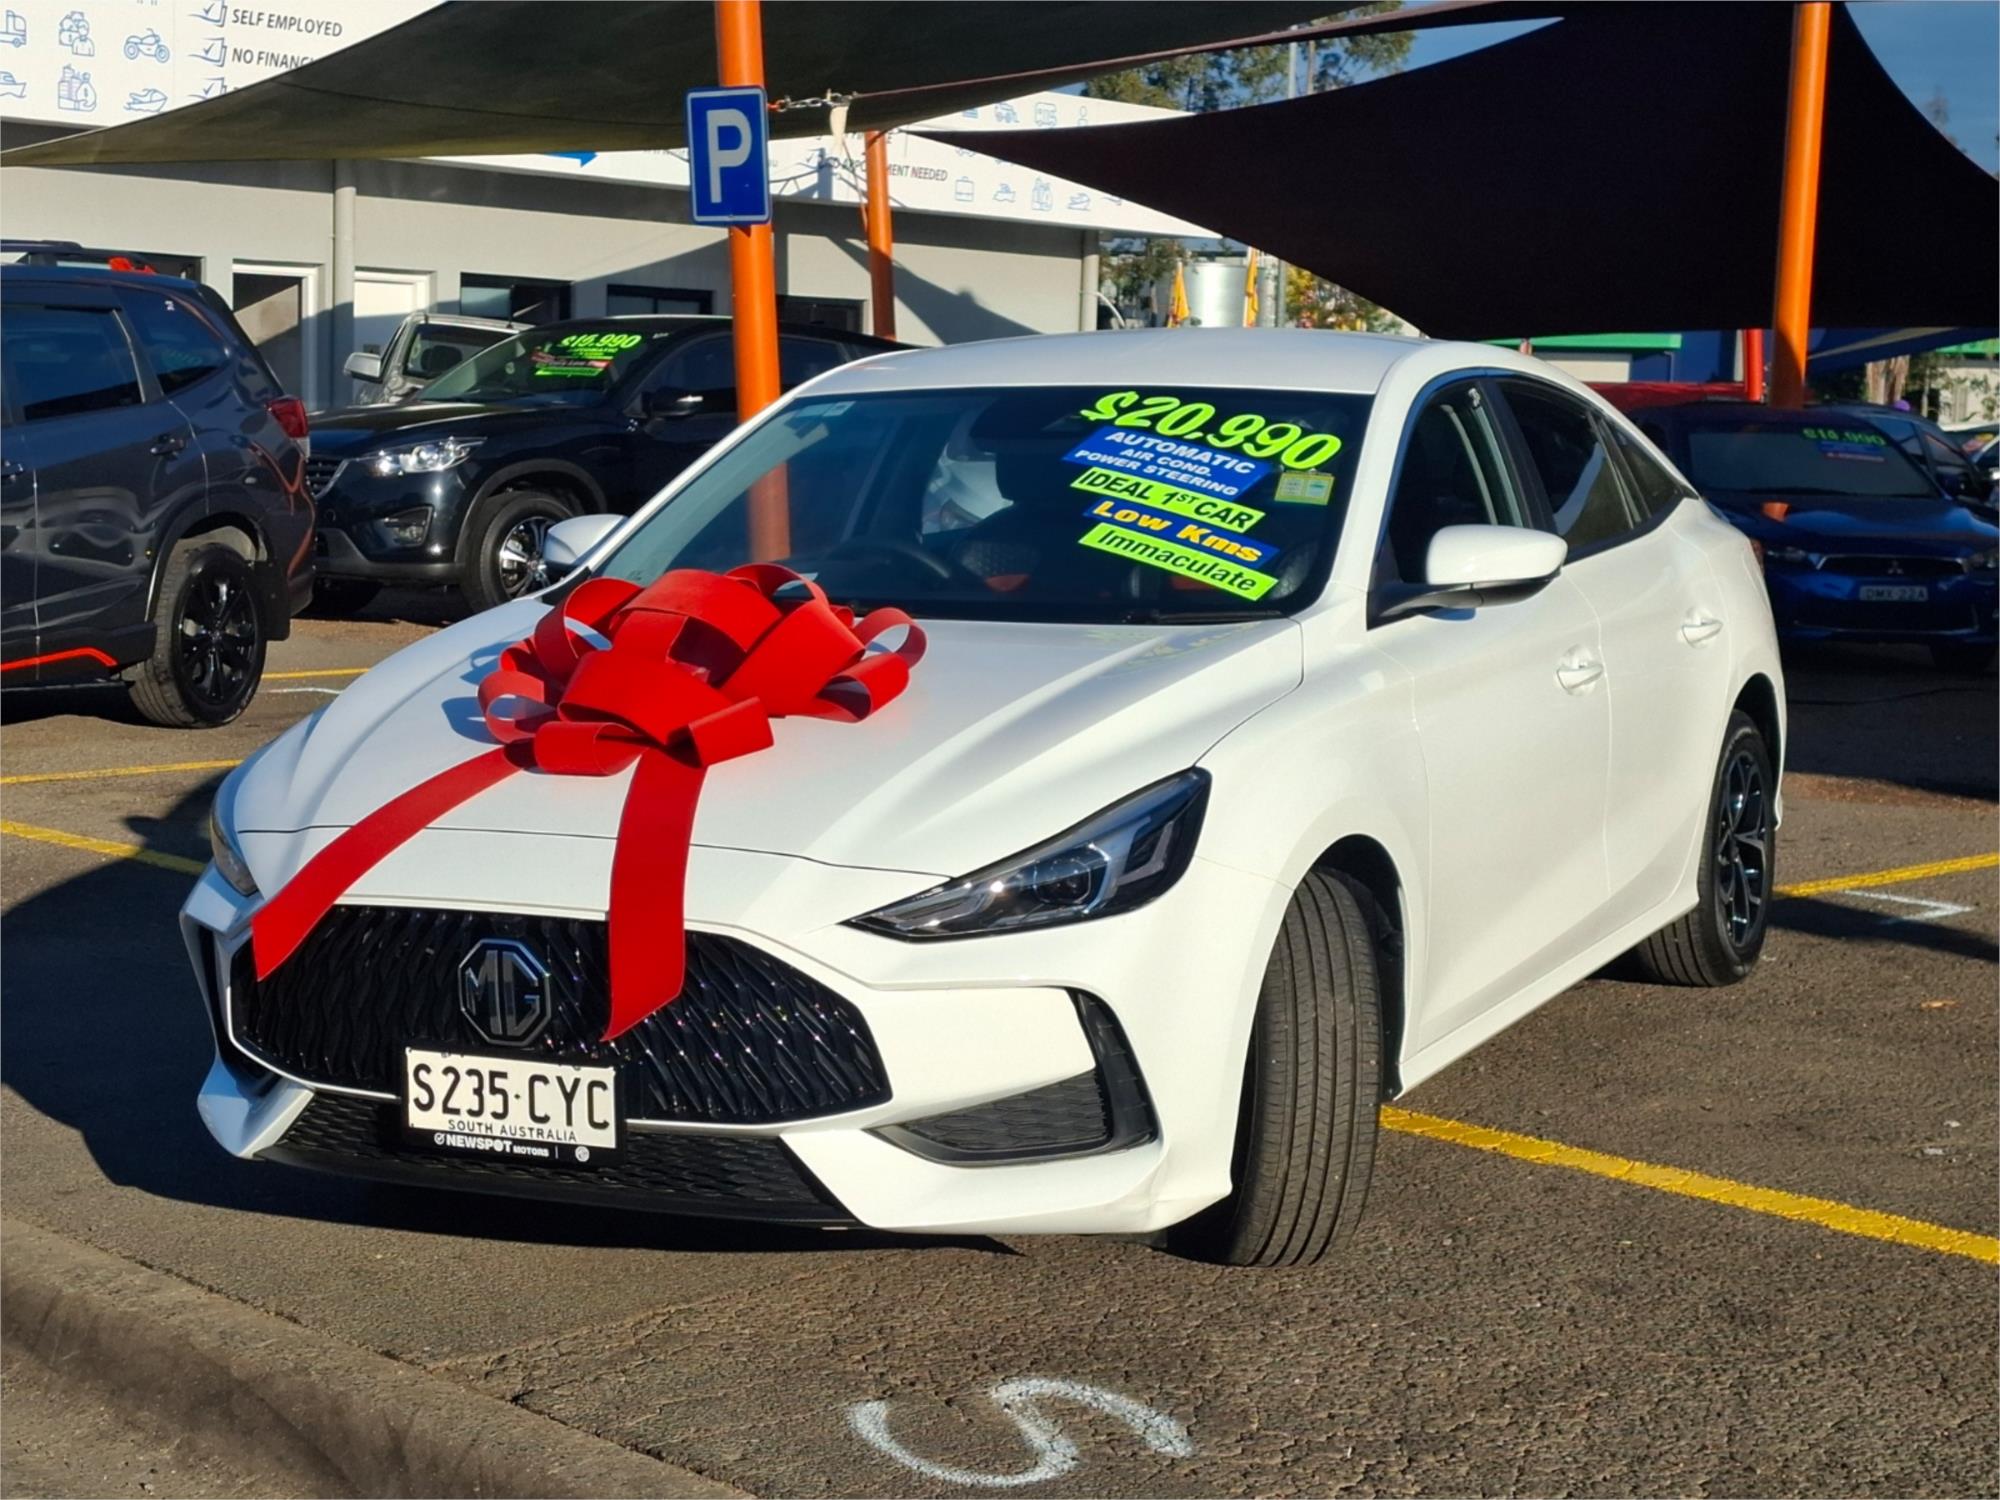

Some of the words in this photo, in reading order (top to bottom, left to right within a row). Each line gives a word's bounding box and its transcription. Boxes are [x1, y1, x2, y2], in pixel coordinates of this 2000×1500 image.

[232, 9, 265, 26] SELF
[267, 14, 342, 37] EMPLOYED
[232, 48, 254, 64] NO
[706, 108, 752, 203] P
[911, 165, 948, 181] NEEDED
[1105, 431, 1256, 474] AUTOMATIC
[1120, 449, 1155, 461] AIR
[1157, 456, 1211, 477] COND.
[1074, 450, 1142, 470] POWER
[1143, 465, 1239, 495] STEERING
[1078, 471, 1154, 500] IDEAL
[1194, 502, 1254, 529] CAR
[1098, 530, 1257, 591] Immaculate
[465, 950, 540, 1036] MG
[446, 1133, 512, 1153] NEWSPOT
[513, 1145, 549, 1157] MOTORS
[448, 1119, 494, 1134] SOUTH
[500, 1125, 577, 1142] AUSTRALIA
